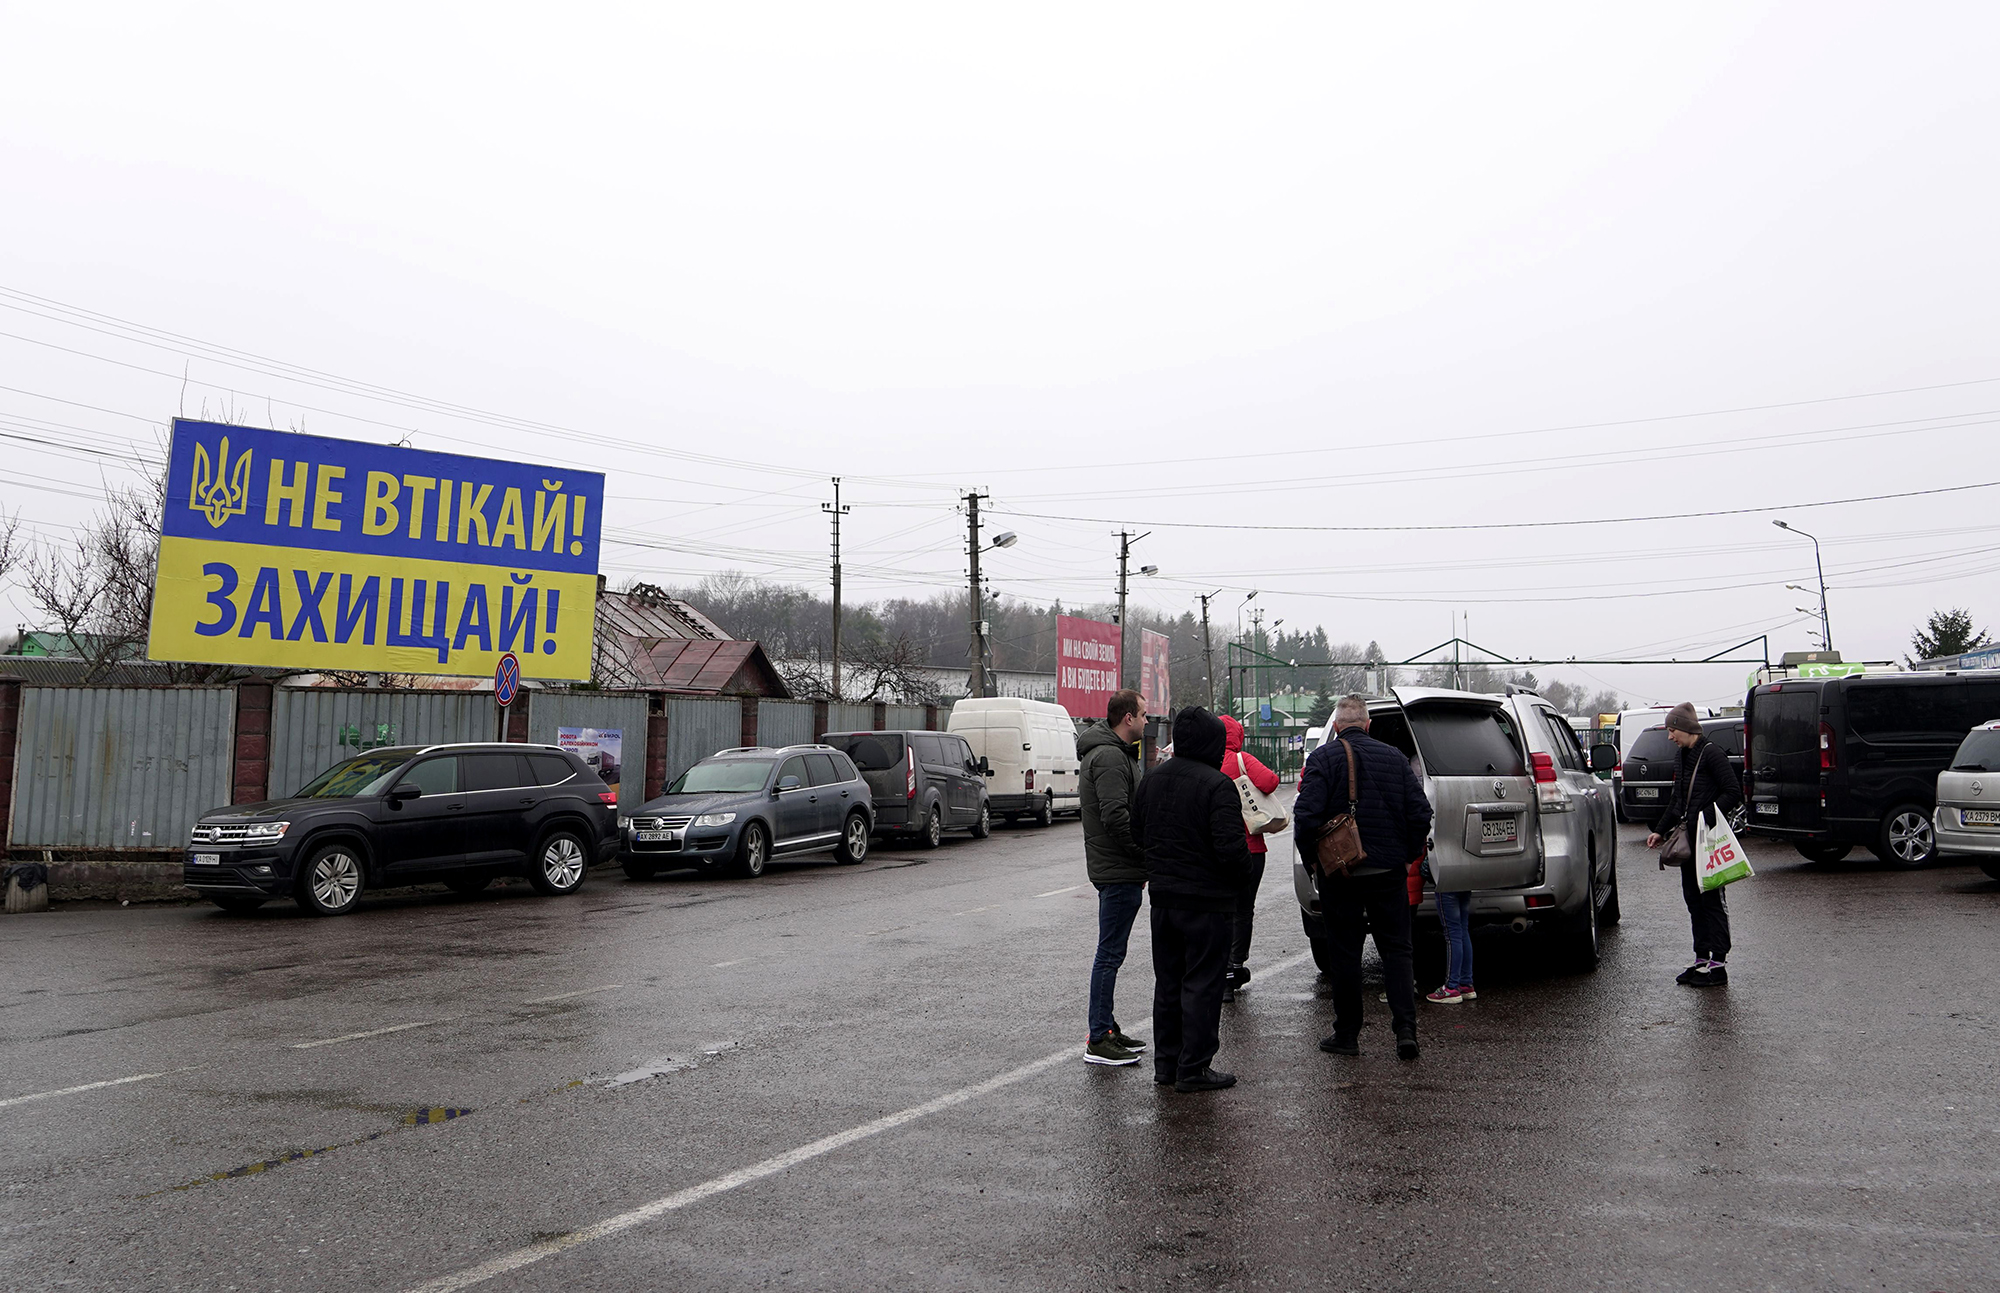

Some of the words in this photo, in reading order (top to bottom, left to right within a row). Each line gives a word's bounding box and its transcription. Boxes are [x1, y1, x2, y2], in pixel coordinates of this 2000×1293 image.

[264, 458, 346, 532] НЕ
[362, 471, 586, 557] ВТІКАЙ!
[194, 561, 560, 665] ЗАХИЩАЙ!
[1063, 638, 1073, 657] МИ
[1073, 639, 1081, 659] НА
[1061, 666, 1067, 688] А
[1067, 666, 1077, 689] ВИ
[1077, 667, 1100, 694] БУДЕТЕ
[1100, 670, 1106, 691] В
[1506, 821, 1515, 835] EE
[1975, 812, 1990, 822] 2379
